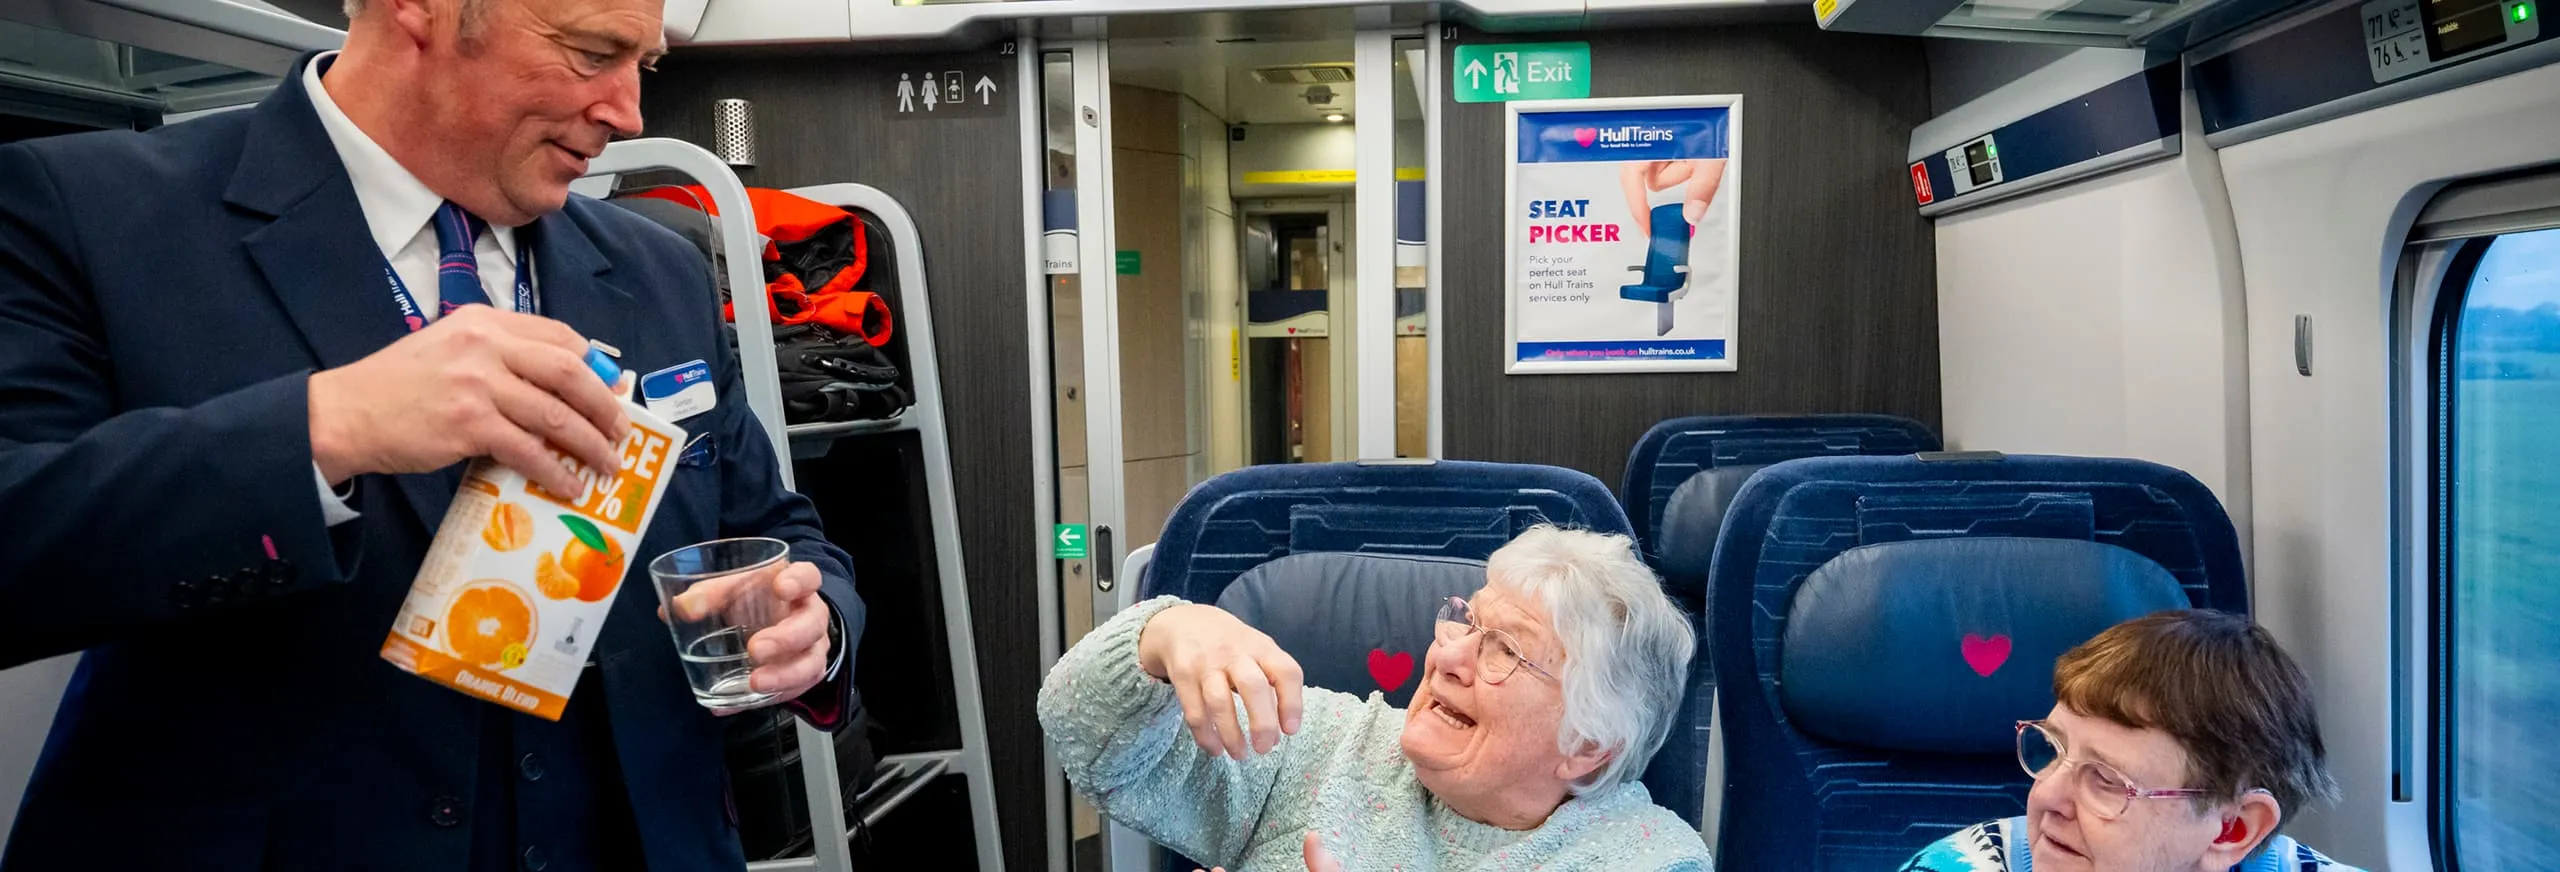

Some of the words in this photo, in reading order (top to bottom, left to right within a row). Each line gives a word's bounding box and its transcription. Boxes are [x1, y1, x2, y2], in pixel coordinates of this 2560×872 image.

[2368, 14, 2383, 39] 77
[1443, 27, 1458, 40] J1
[1000, 42, 1015, 54] J2
[2374, 45, 2391, 68] 76
[1527, 61, 1572, 82] Exit
[1528, 200, 1589, 219] SEAT
[1529, 224, 1620, 243] PICKER
[1529, 256, 1549, 264] Pick
[1551, 257, 1573, 265] your
[1529, 268, 1564, 279] perfect
[1567, 268, 1587, 276] seat
[1544, 281, 1563, 289] Hull
[1567, 280, 1594, 289] Trains
[1529, 294, 1567, 303] services
[1570, 293, 1590, 304] only
[1639, 346, 1695, 356] hulltrains.co.uk
